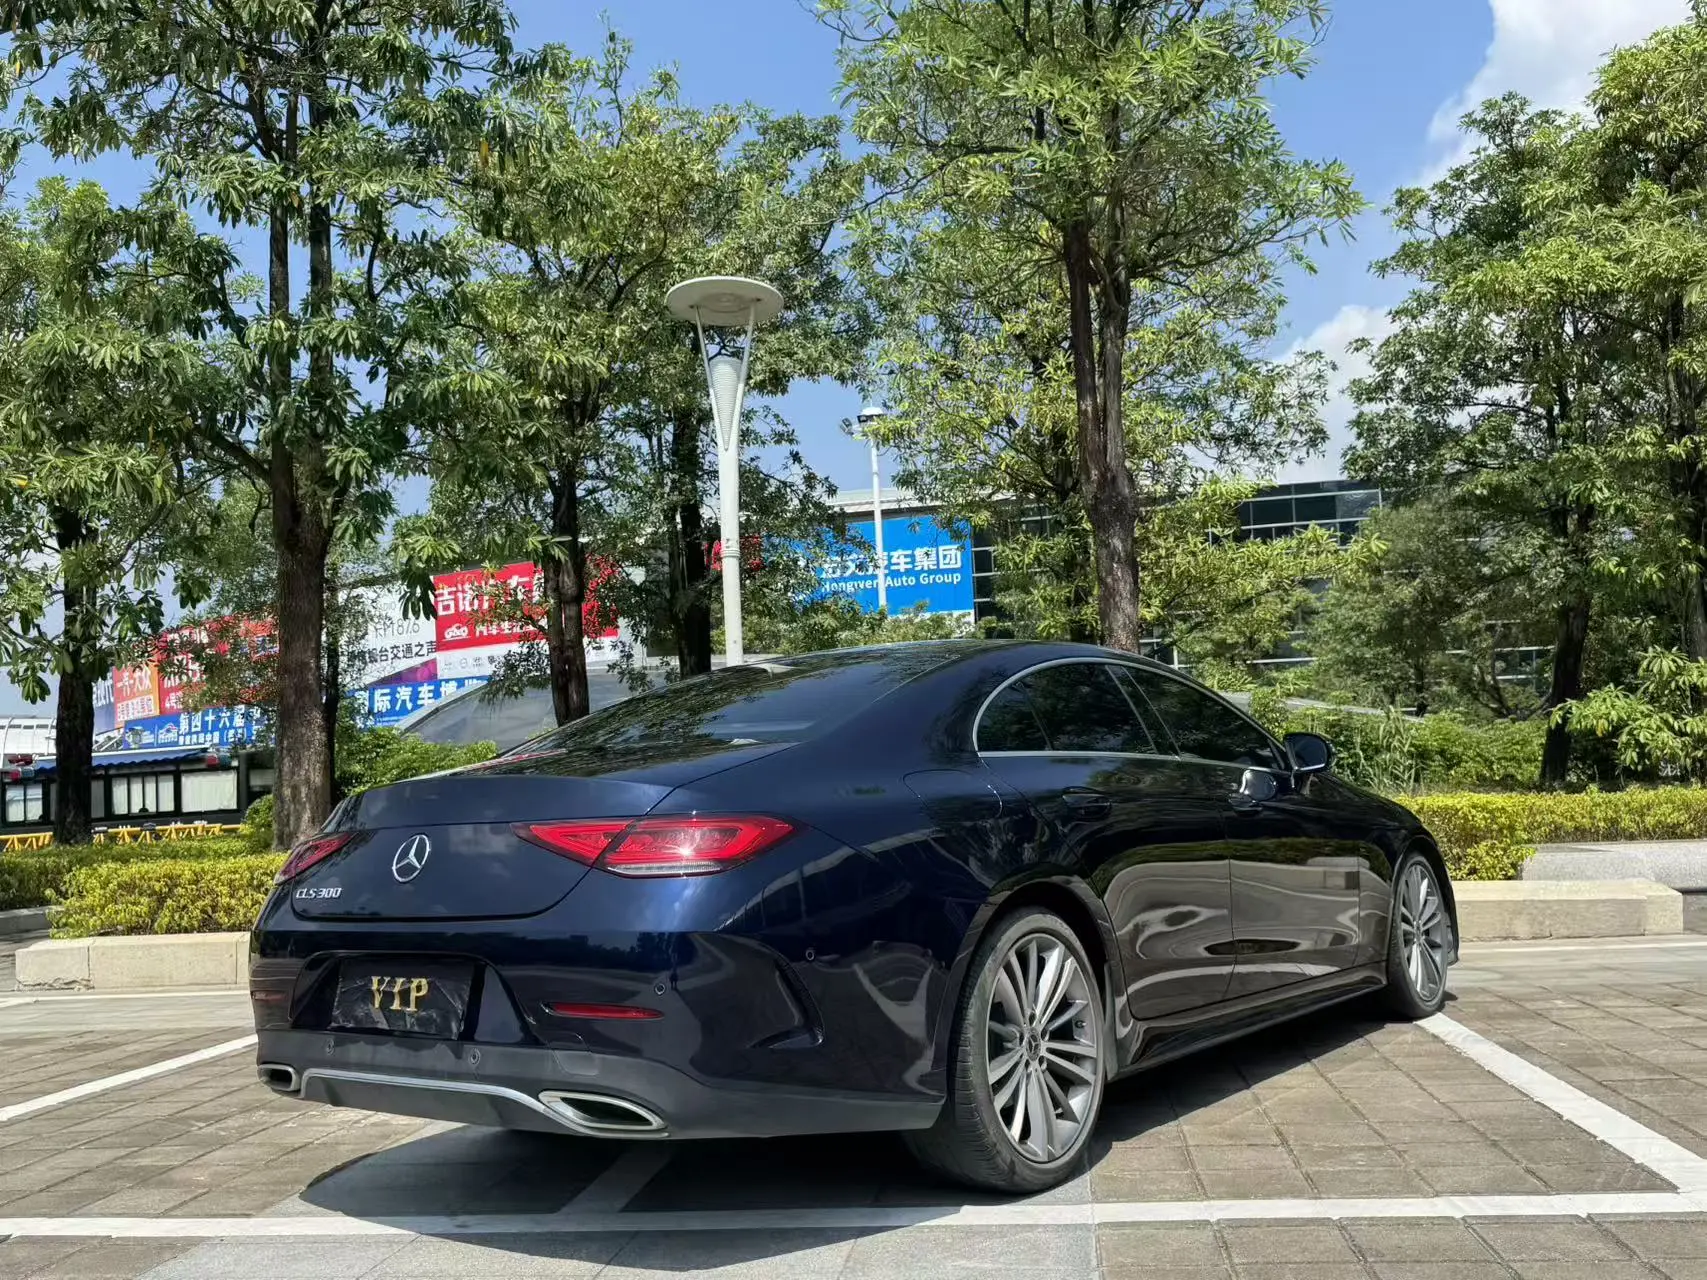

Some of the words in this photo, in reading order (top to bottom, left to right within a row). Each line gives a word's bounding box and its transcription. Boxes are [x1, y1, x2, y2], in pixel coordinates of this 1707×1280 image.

[885, 575, 916, 587] Auto
[919, 572, 962, 585] Group
[371, 975, 429, 1012] VIP
